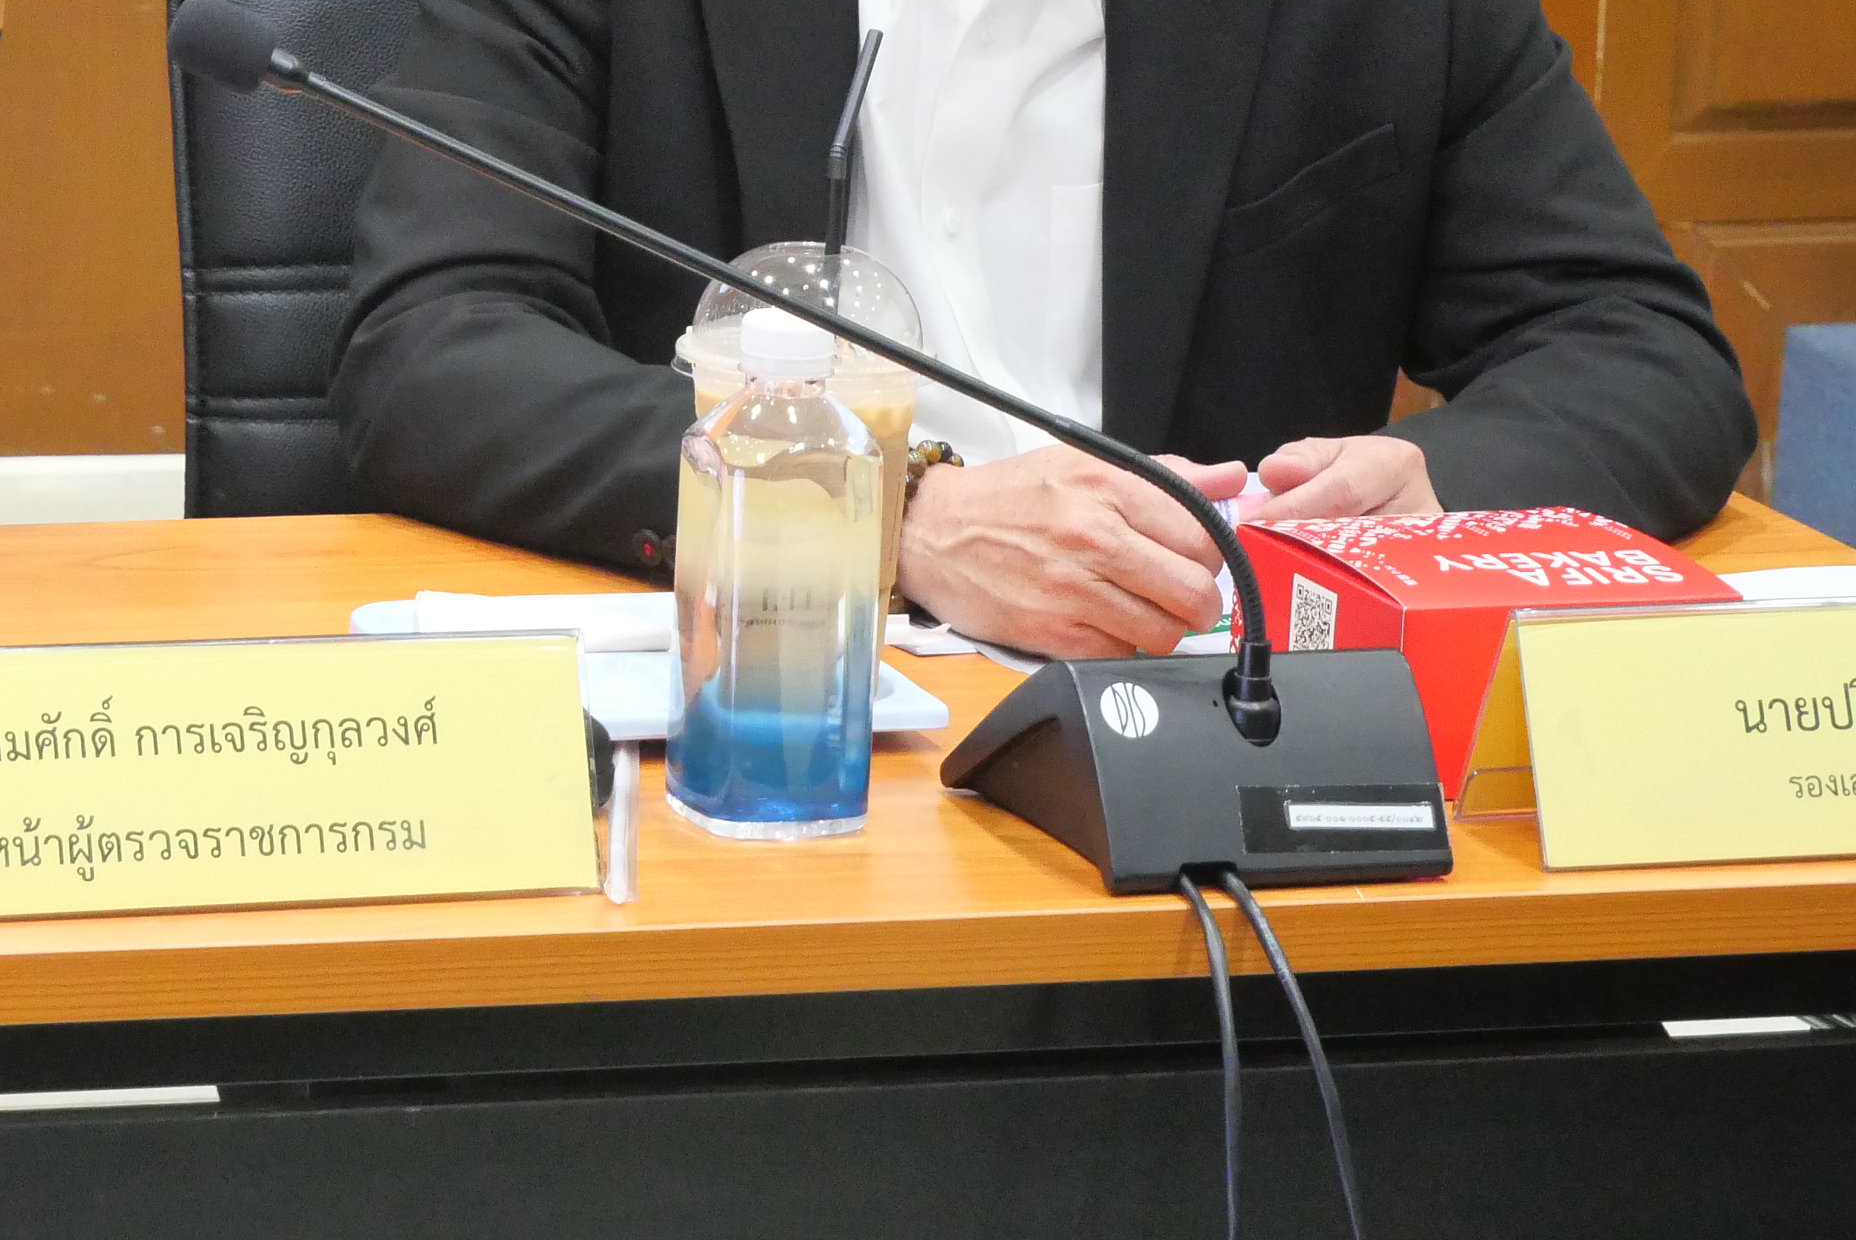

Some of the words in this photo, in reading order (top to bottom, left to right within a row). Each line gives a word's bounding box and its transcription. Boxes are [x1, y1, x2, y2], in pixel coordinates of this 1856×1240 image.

[1434, 549, 1661, 571] BAKERY
[1507, 565, 1684, 587] SRIFA
[134, 695, 439, 765] การเจริญกุลวงศ์
